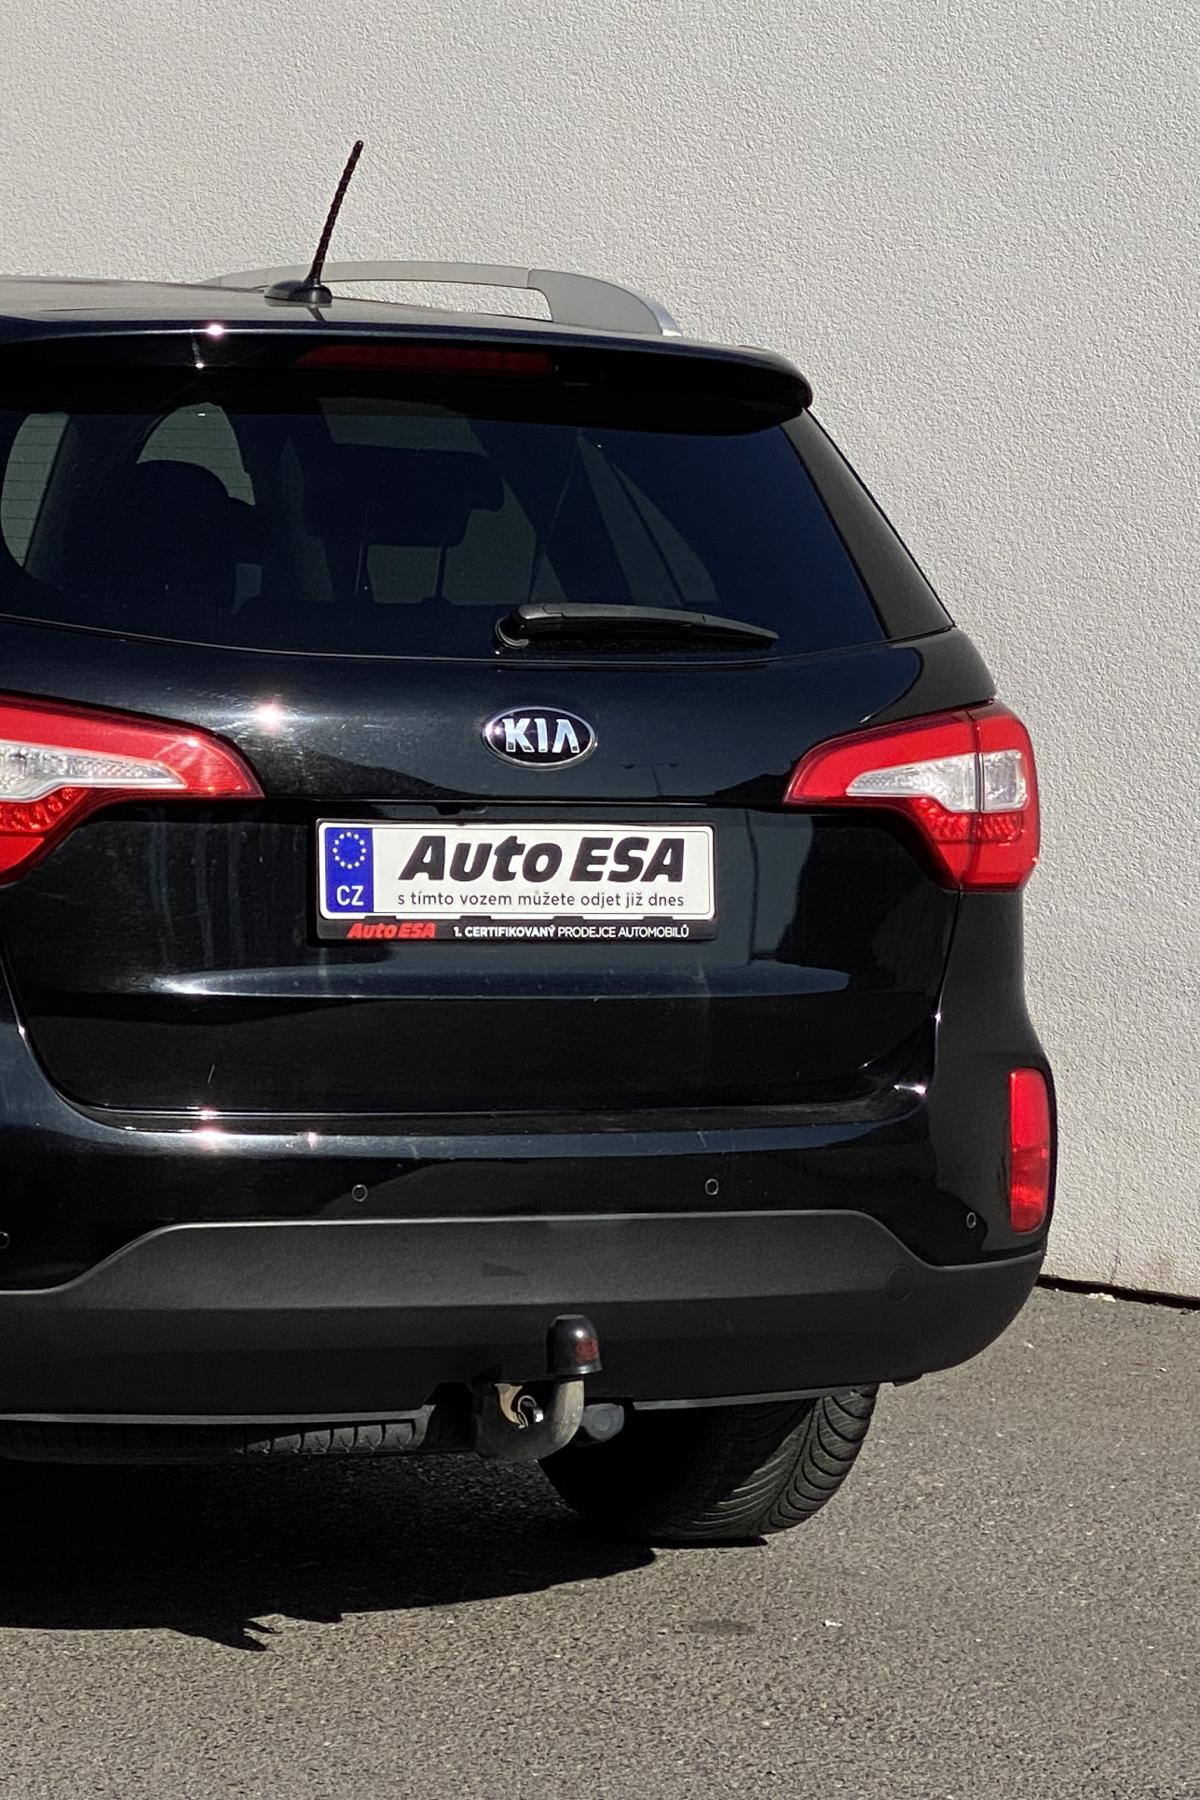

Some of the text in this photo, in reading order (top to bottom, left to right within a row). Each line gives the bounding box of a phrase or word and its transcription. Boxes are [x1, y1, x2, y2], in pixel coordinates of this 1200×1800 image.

[502, 718, 580, 753] KIA
[398, 835, 685, 882] Auto ESA
[336, 885, 364, 906] CZ
[398, 890, 684, 909] s tímto vozem můžete odjet již dnes
[347, 922, 437, 939] Auto ESA
[453, 924, 689, 938] 1. CERTIFIKOVANÝ PRODEJCE AUTOMOBILŮ
